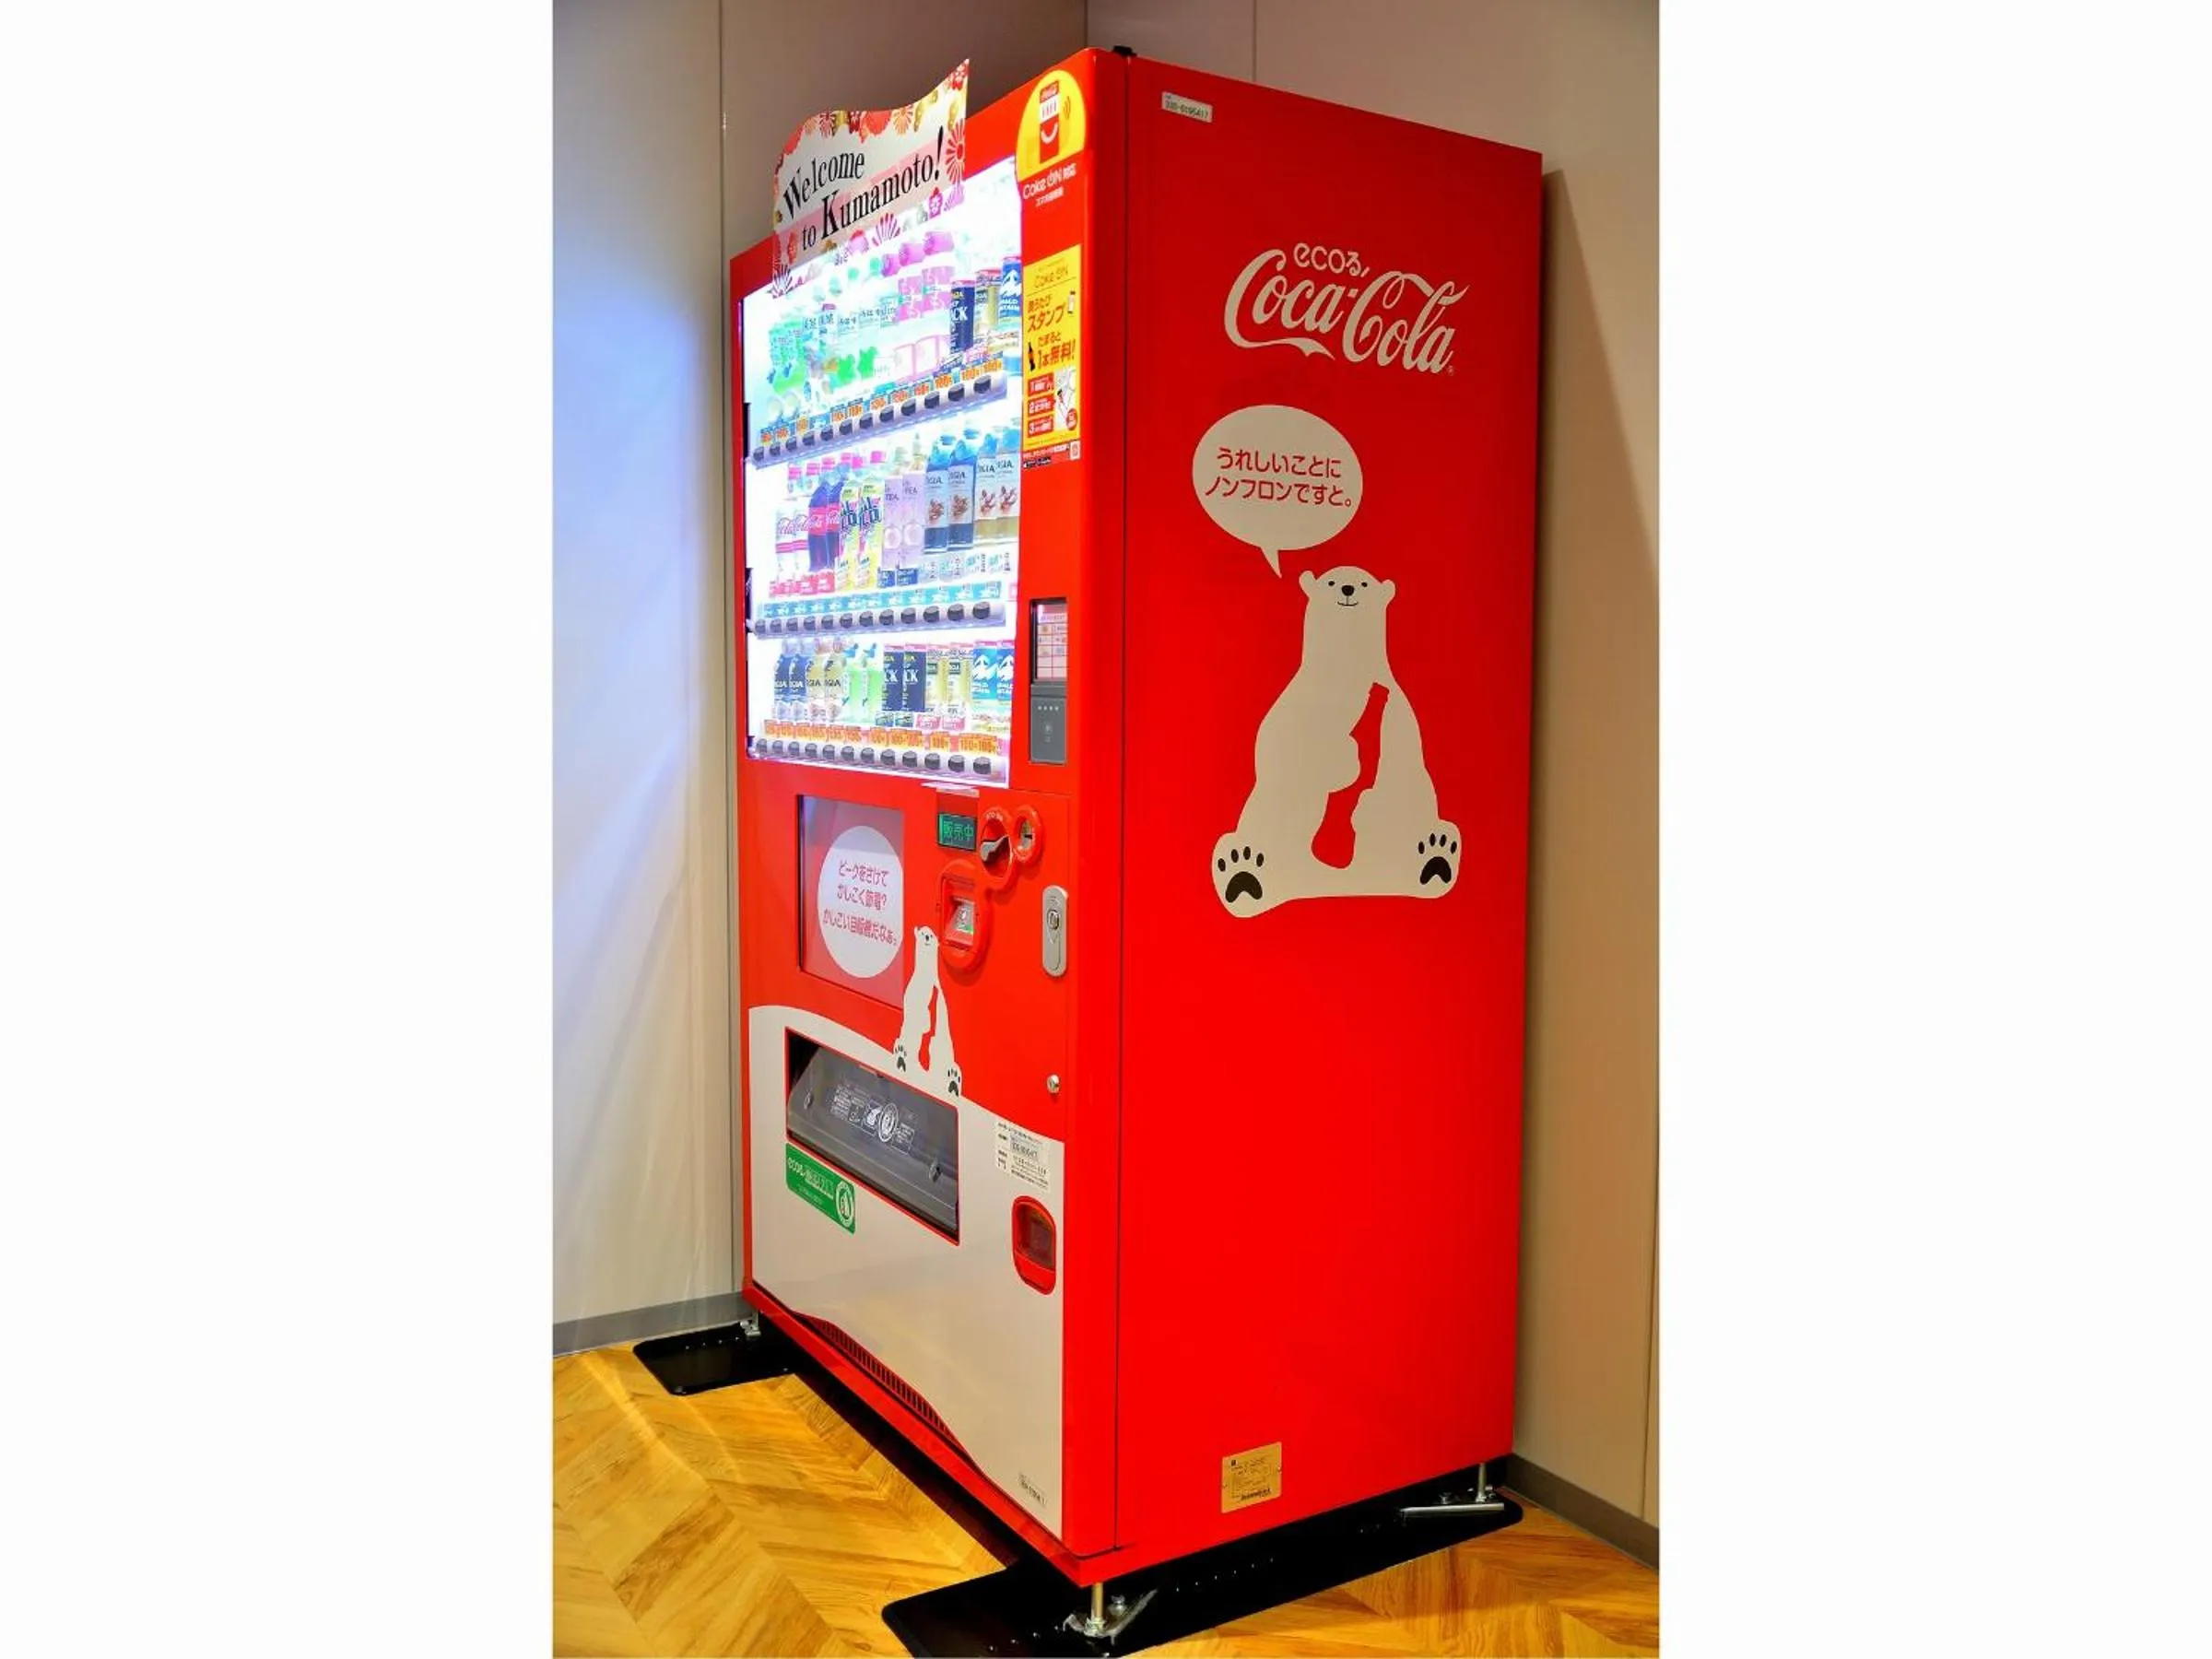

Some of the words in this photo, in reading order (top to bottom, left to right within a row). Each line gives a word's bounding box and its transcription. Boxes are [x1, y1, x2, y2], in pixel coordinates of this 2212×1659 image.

[783, 149, 865, 220] Welcome
[802, 224, 817, 251] to
[821, 125, 945, 240] Kumamoto!
[1224, 248, 1470, 374] Coca-Cola
[1205, 476, 1352, 509] ノンフロンですと。
[1216, 448, 1342, 478] うれしいことに
